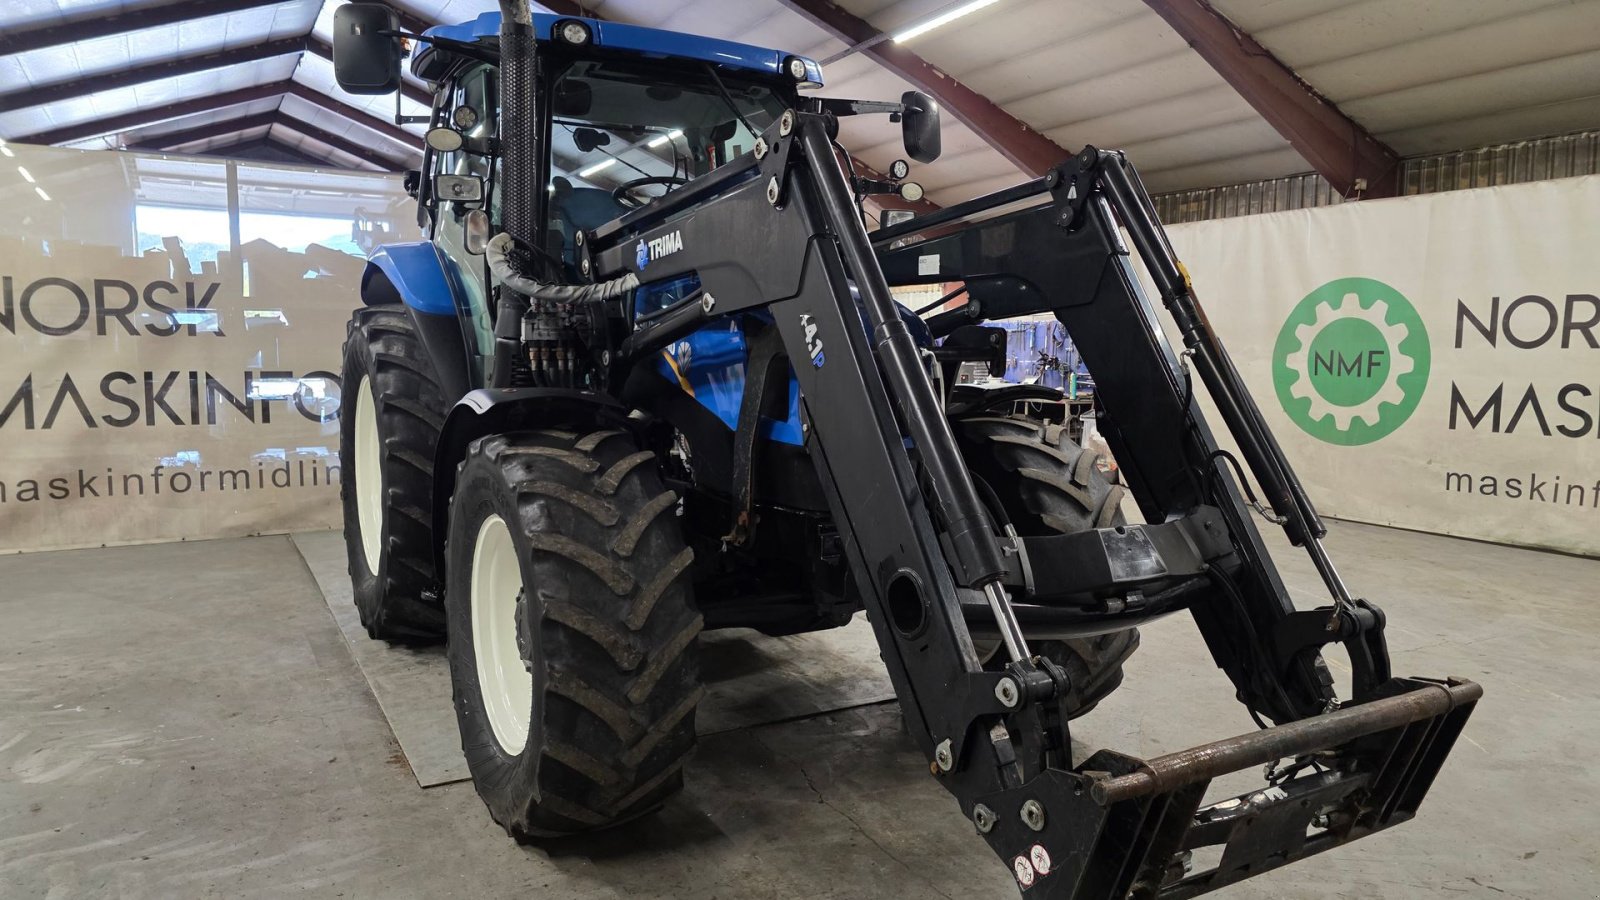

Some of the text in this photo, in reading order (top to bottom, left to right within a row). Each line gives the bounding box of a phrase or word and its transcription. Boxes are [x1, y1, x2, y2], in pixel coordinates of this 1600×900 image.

[648, 230, 683, 260] TRIMA
[0, 275, 226, 337] ORSK
[1454, 294, 1600, 350] NOR
[1314, 349, 1385, 378] NMF
[1448, 380, 1600, 440] MAS
